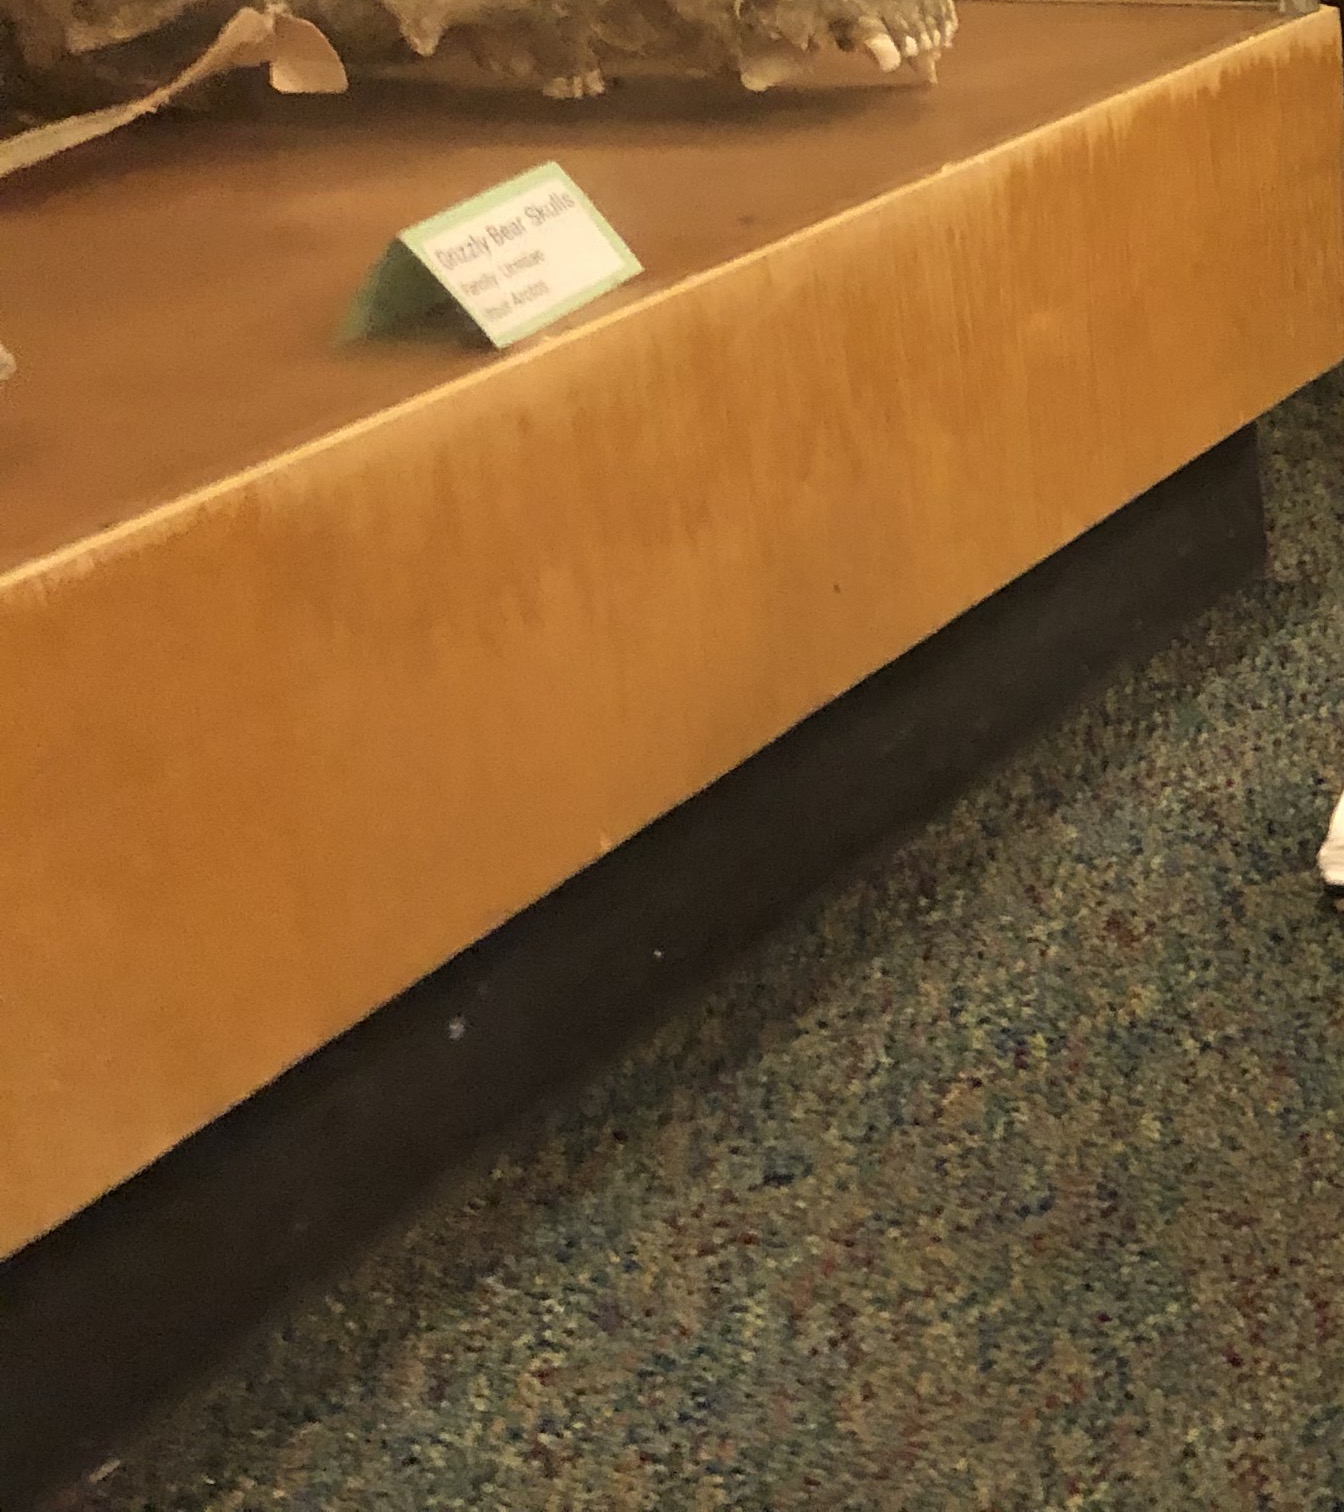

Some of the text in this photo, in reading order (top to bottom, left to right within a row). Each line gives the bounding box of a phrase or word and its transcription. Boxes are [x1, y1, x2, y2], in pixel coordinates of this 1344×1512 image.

[436, 192, 575, 270] Grizzly Bear Skulls
